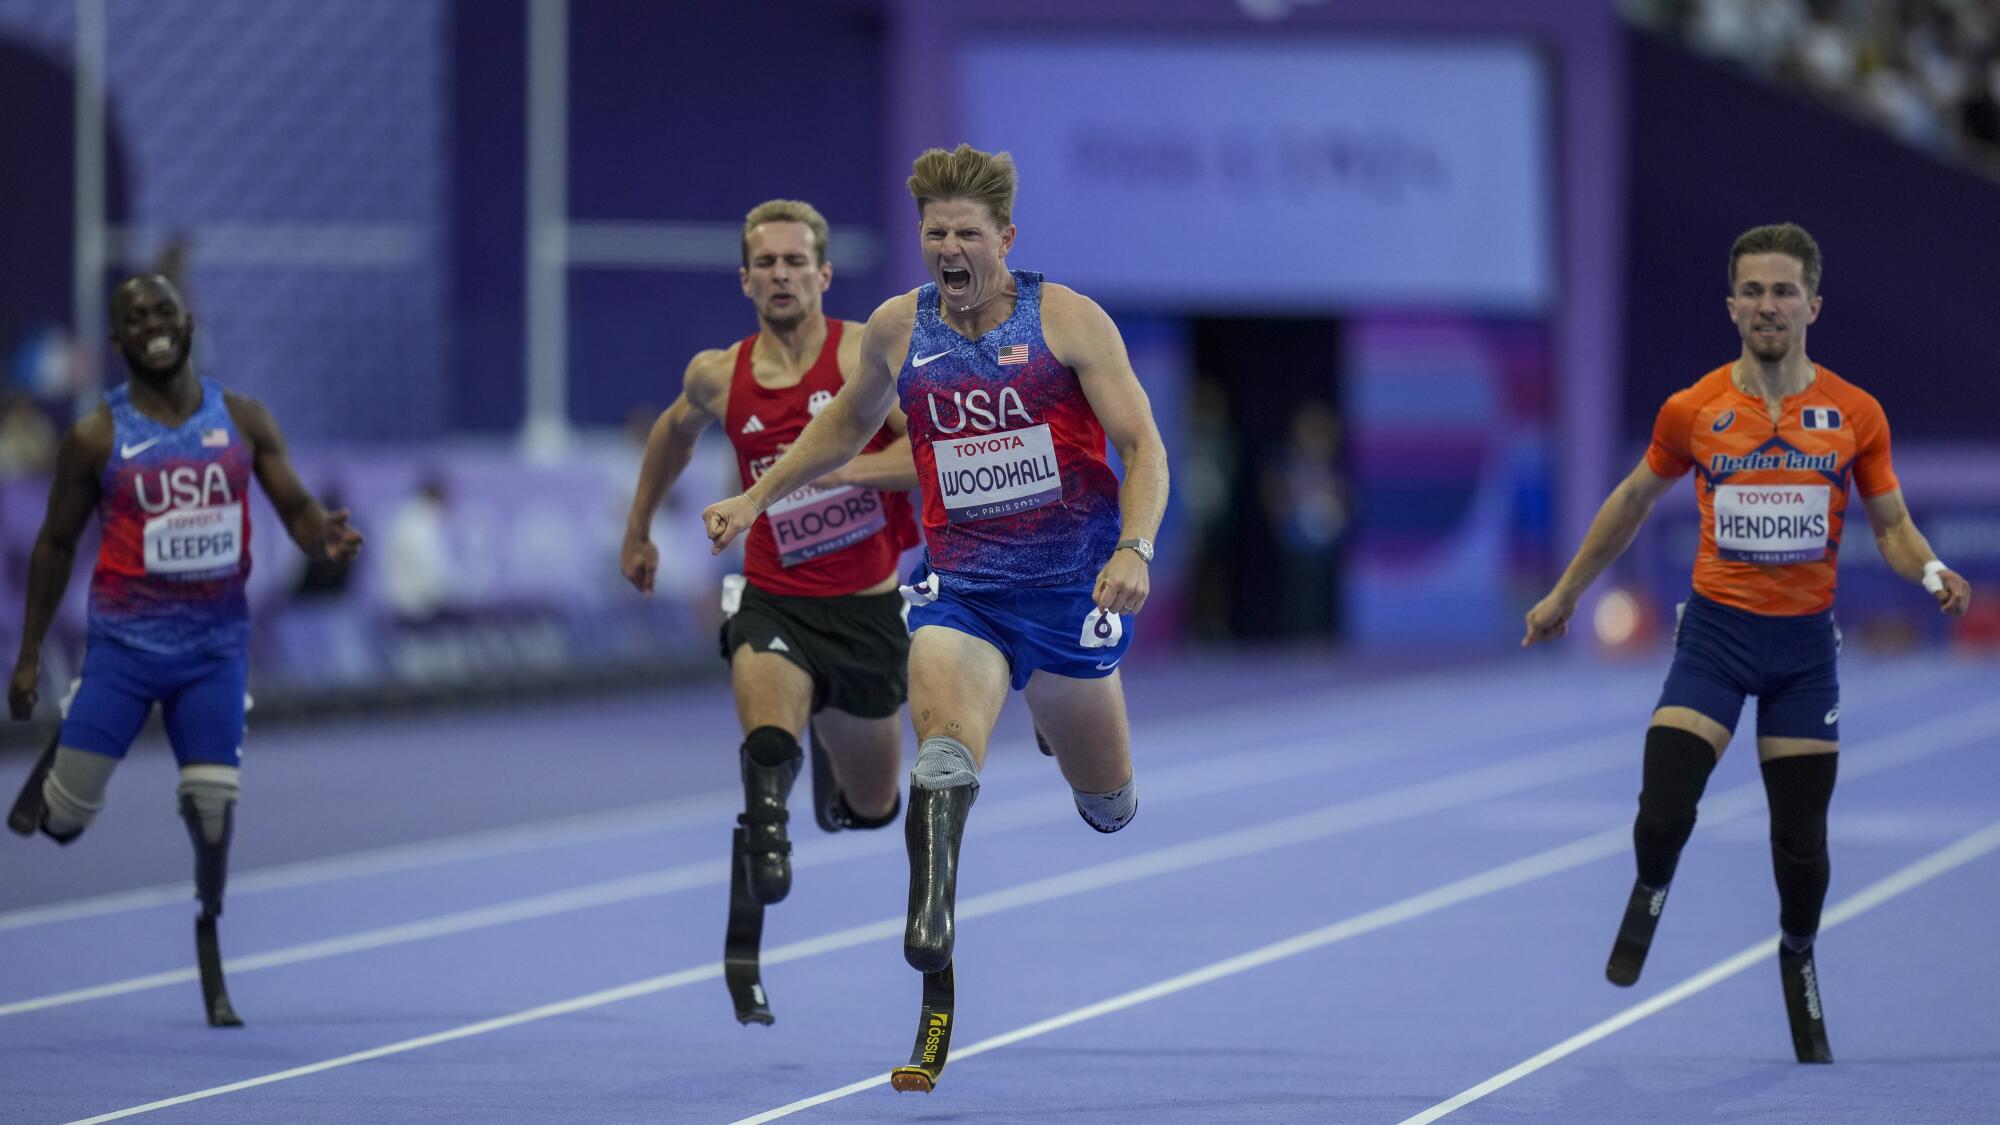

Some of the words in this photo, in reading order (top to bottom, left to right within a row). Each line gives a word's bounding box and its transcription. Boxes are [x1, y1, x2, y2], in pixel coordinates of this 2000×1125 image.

[927, 386, 1034, 434] USA
[953, 436, 1025, 458] TOYOTA
[135, 463, 232, 513] USA
[941, 455, 1056, 497] WOODHALL
[982, 504, 1011, 515] PARIS
[1014, 498, 1041, 510] 2024
[1736, 491, 1805, 505] TOYOTA
[775, 489, 878, 546] FLOORS
[1719, 514, 1826, 539] HENDRIKS
[157, 529, 235, 562] LEEPER
[1093, 610, 1113, 640] 6
[922, 1027, 945, 1063] ÖSSUR
